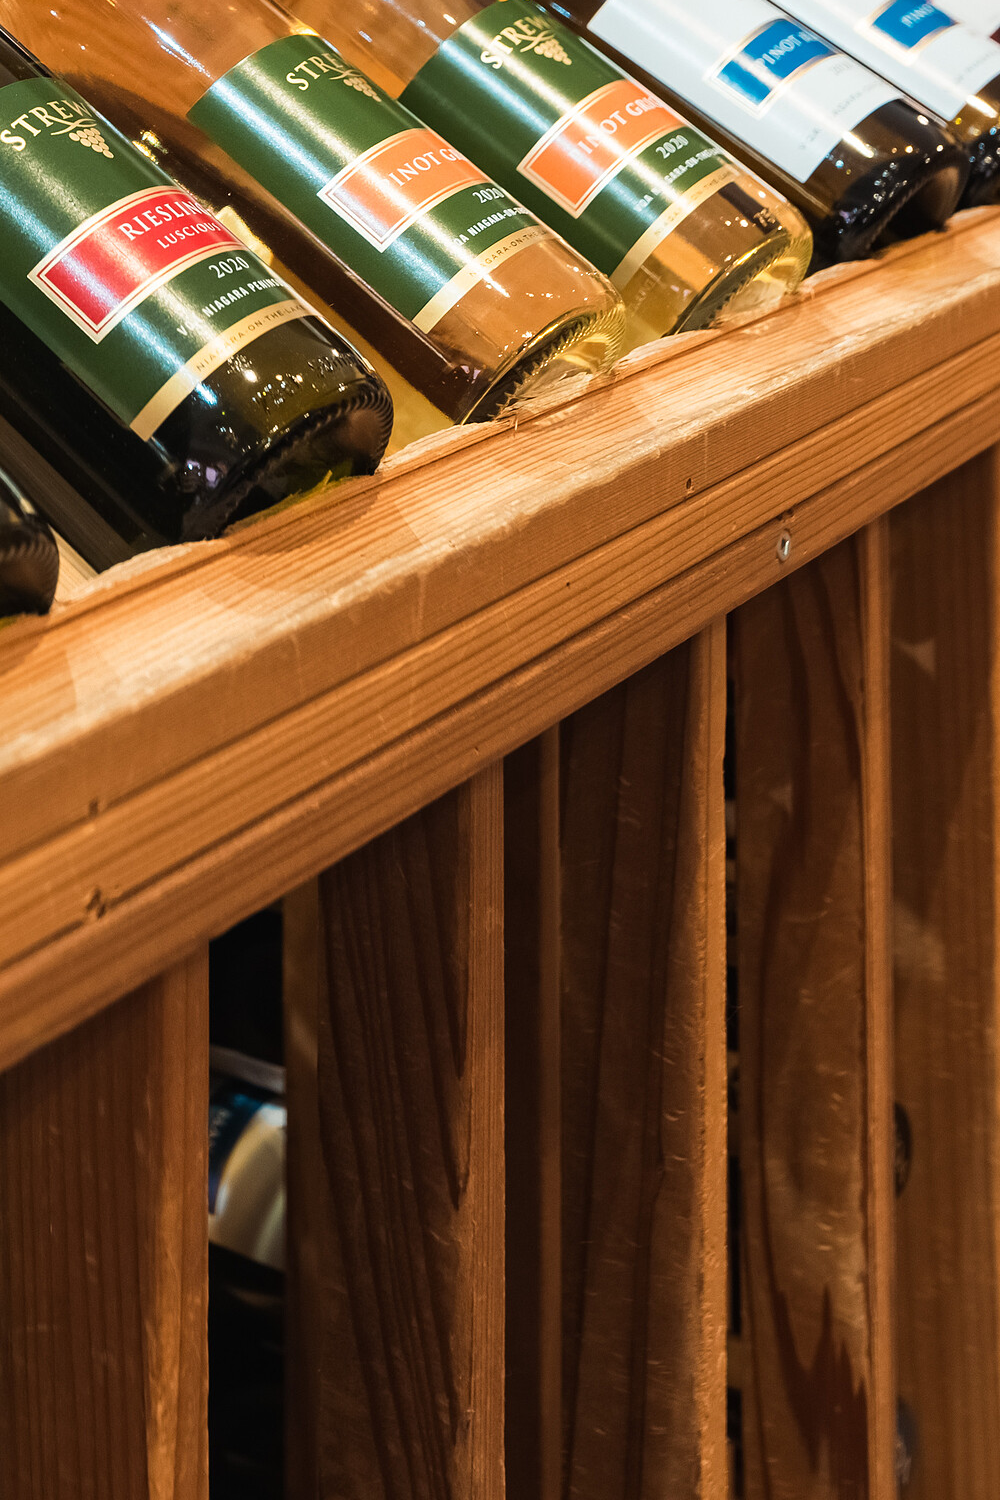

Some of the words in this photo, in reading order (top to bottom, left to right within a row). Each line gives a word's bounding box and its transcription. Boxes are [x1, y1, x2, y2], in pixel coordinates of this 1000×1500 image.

[480, 15, 552, 70] STREW
[285, 52, 346, 91] STRE
[0, 99, 94, 152] STREW
[655, 134, 690, 159] 2020
[378, 151, 442, 190] INOT
[472, 187, 506, 204] 2020
[208, 256, 250, 279] 2020
[201, 286, 250, 318] NIAGARA
